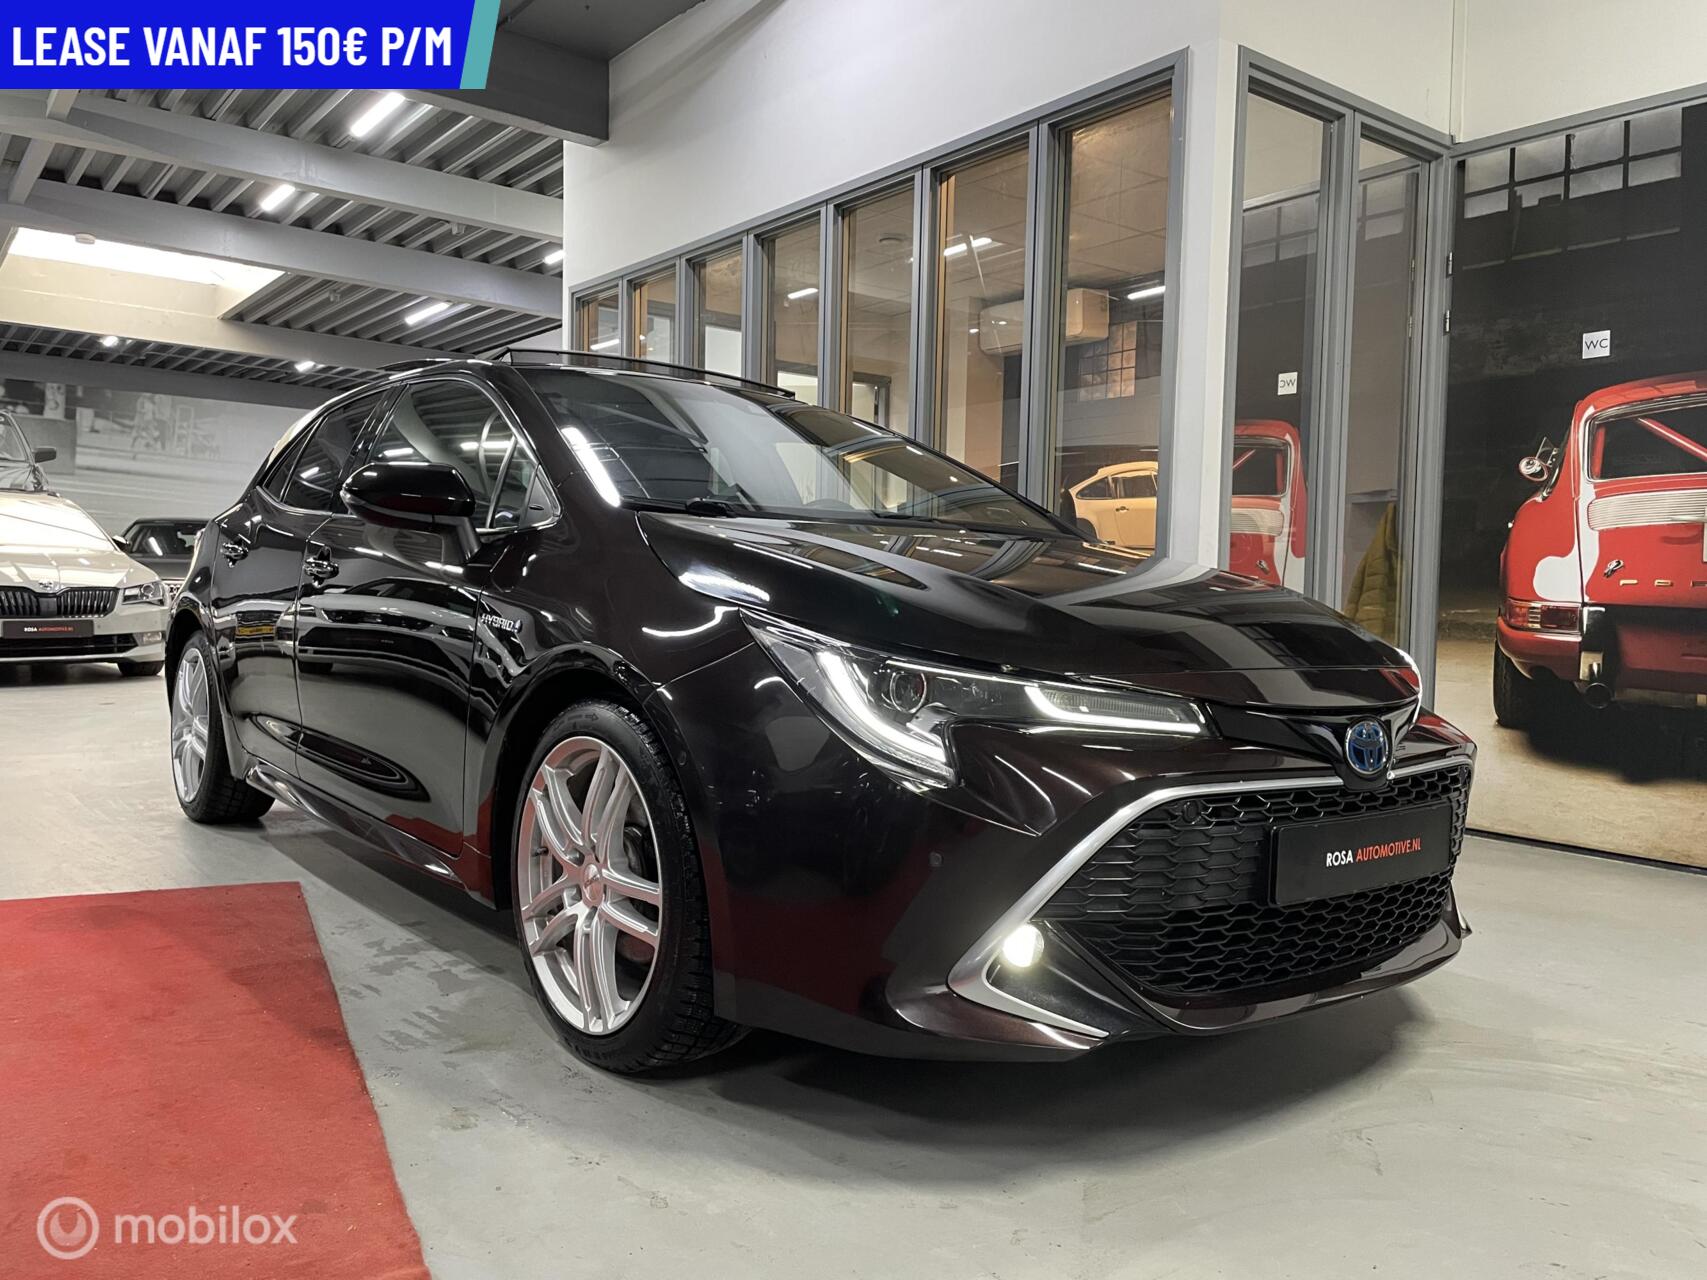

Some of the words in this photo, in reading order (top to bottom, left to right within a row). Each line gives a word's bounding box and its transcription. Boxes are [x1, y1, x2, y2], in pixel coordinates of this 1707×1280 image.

[1585, 338, 1608, 350] WC
[481, 613, 514, 631] HYBRID
[1326, 849, 1354, 867] ROSA
[1356, 837, 1421, 862] AUTOMOTIVE.NL
